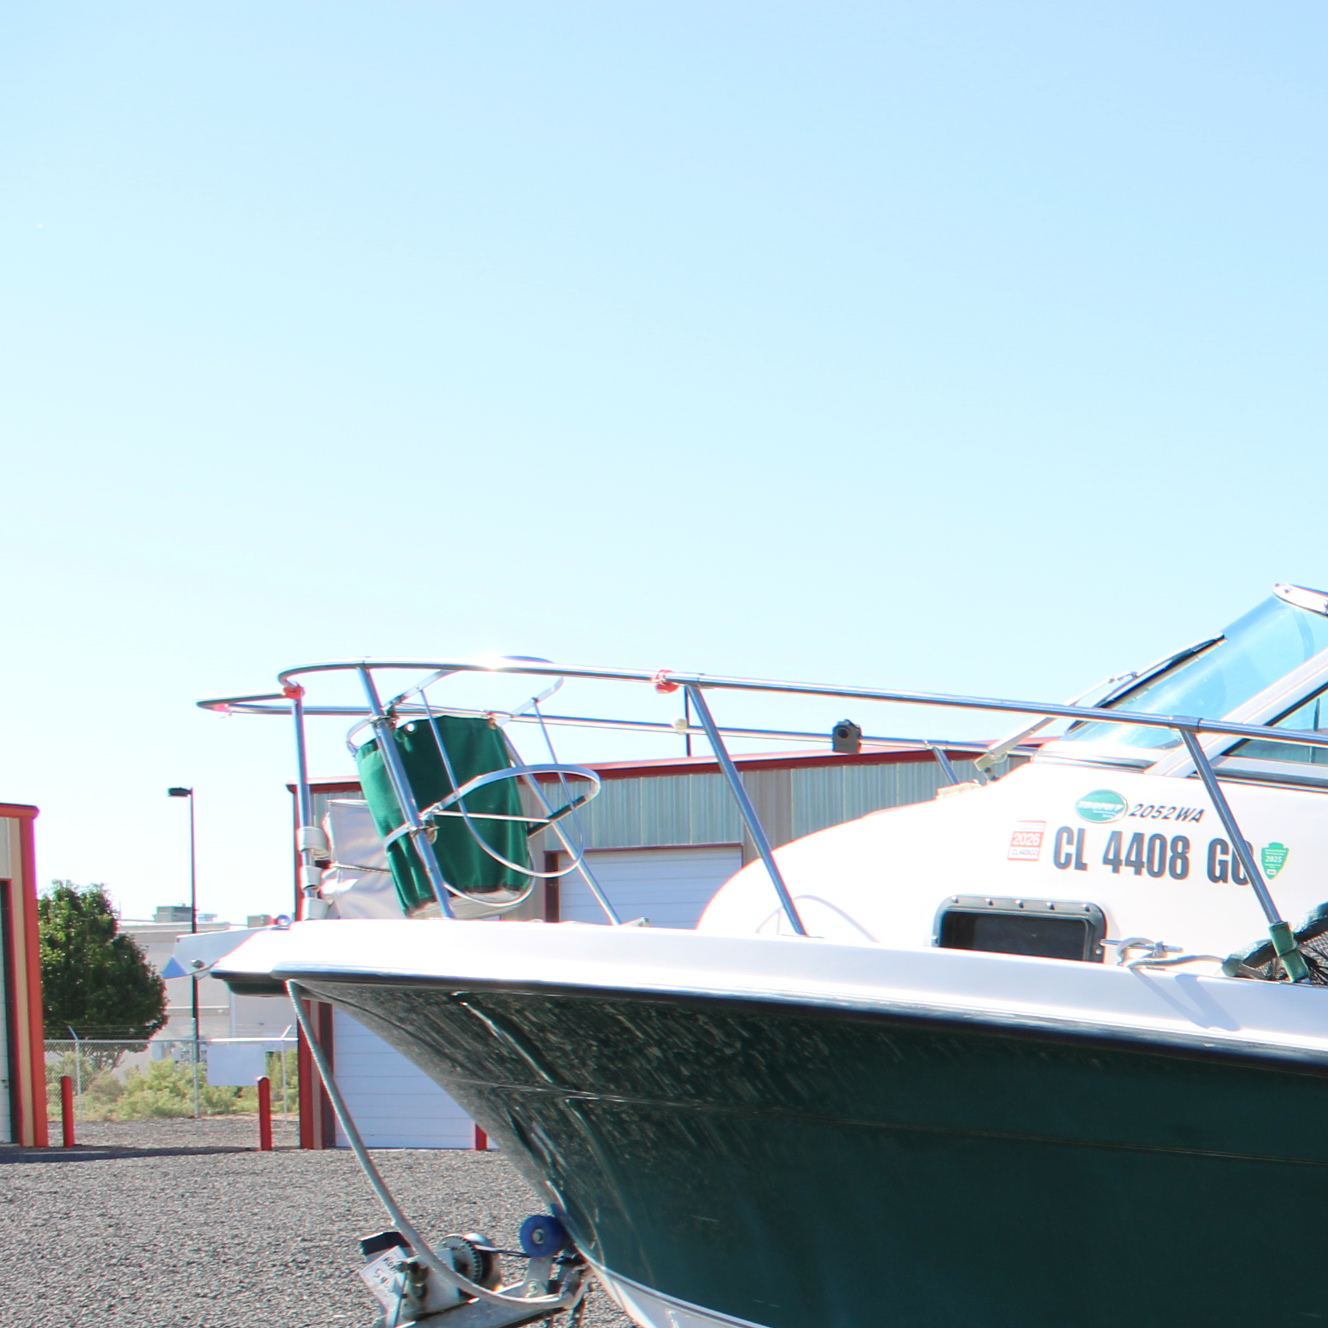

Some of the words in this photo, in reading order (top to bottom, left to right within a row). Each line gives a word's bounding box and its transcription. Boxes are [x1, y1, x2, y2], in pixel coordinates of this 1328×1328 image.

[1128, 803, 1206, 823] 2052WA
[1012, 832, 1041, 846] 2026
[1053, 825, 1089, 872] CL
[1102, 830, 1191, 880] 4408
